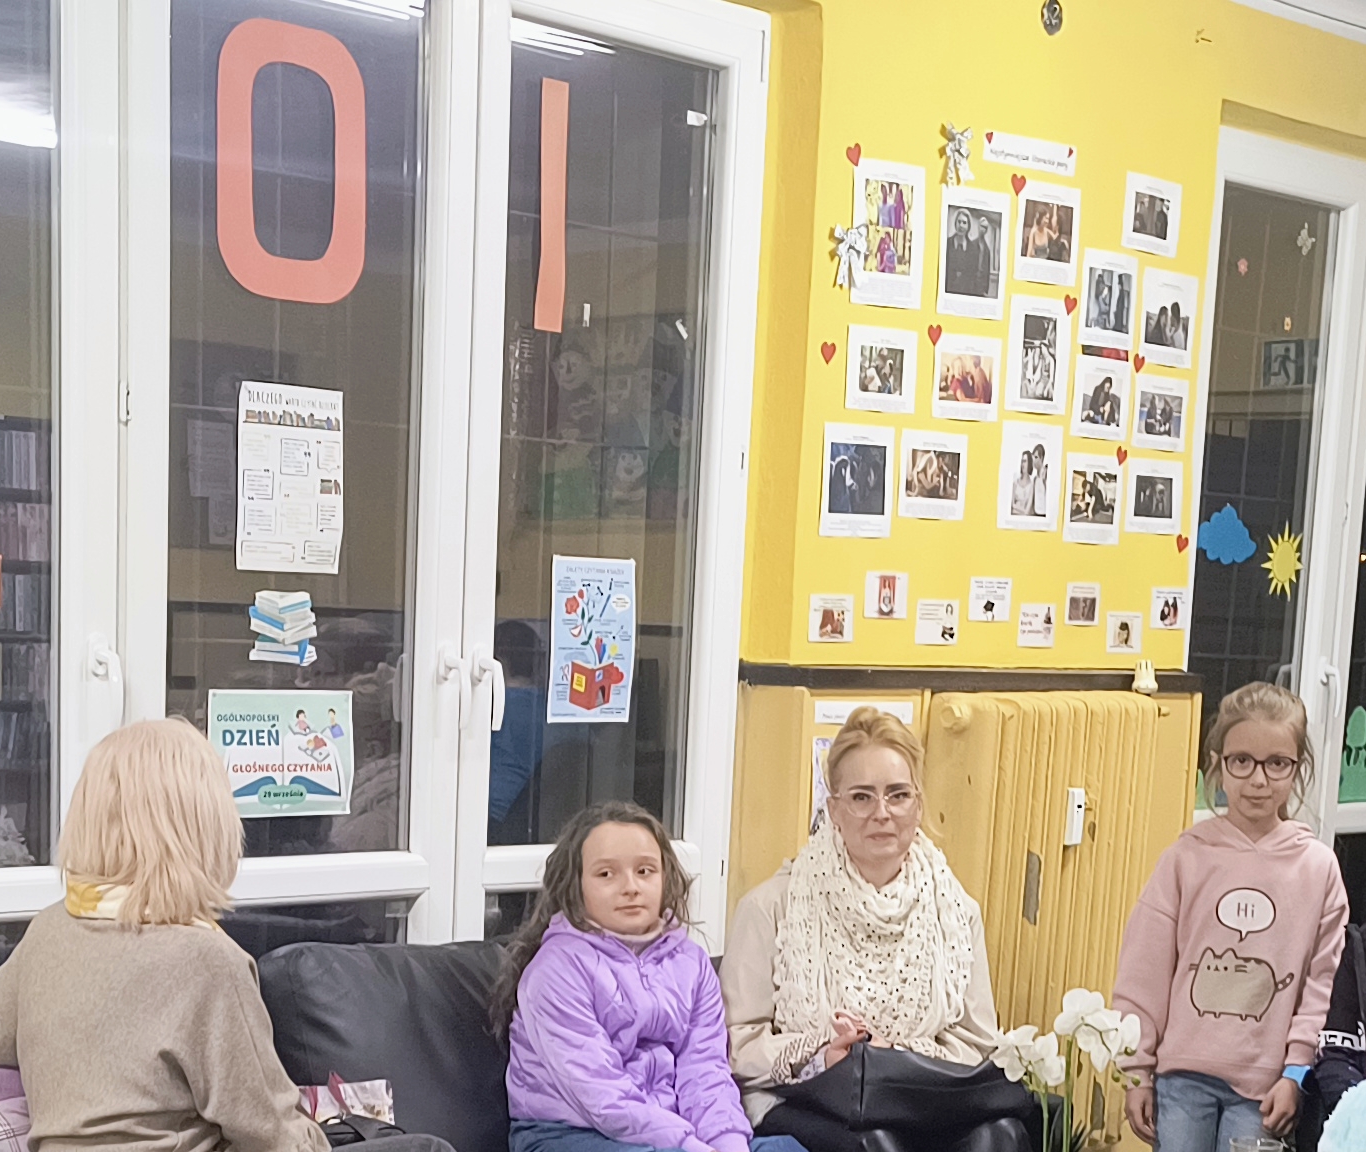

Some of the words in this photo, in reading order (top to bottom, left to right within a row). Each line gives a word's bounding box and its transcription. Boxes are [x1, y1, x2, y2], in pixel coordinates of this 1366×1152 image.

[248, 389, 283, 405] DLACZEGO
[217, 712, 280, 722] OGÓLNOPOLSKI
[222, 723, 280, 746] DZIEŃ
[286, 763, 333, 773] CZYTANIA
[1237, 902, 1255, 918] Hi
